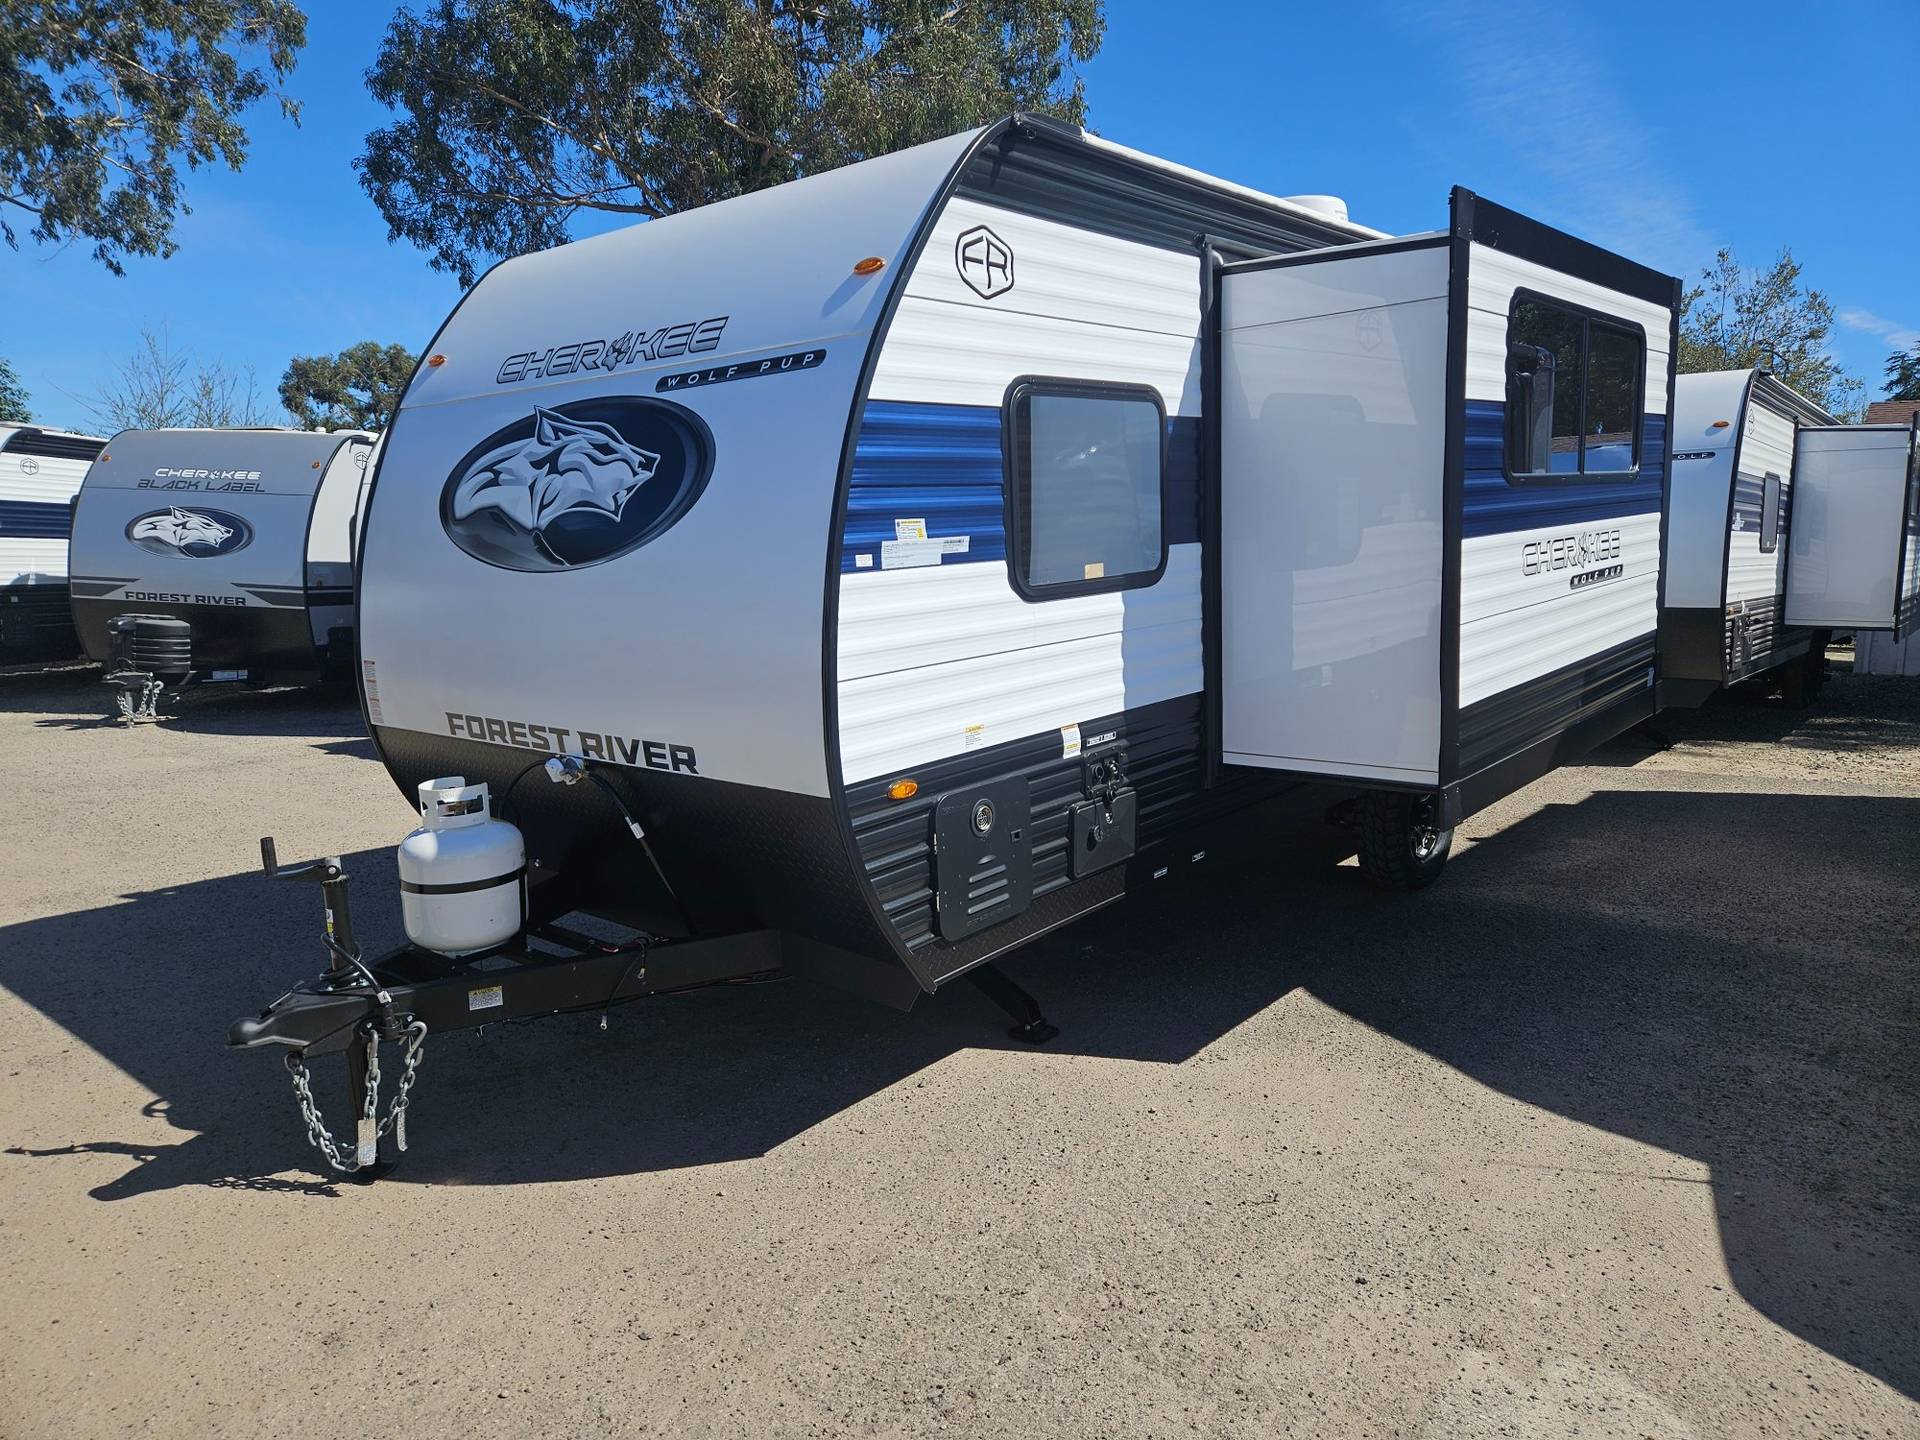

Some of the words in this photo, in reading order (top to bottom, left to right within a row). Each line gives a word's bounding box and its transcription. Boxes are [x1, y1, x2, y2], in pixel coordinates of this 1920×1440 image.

[667, 368, 738, 388] WOLF
[759, 353, 815, 375] PUP
[137, 478, 201, 491] BLACK
[205, 481, 265, 493] LABEL
[125, 591, 191, 603] FOREST
[194, 594, 247, 606] RIVER
[445, 711, 571, 754] FOREST
[576, 730, 700, 775] RIVER
